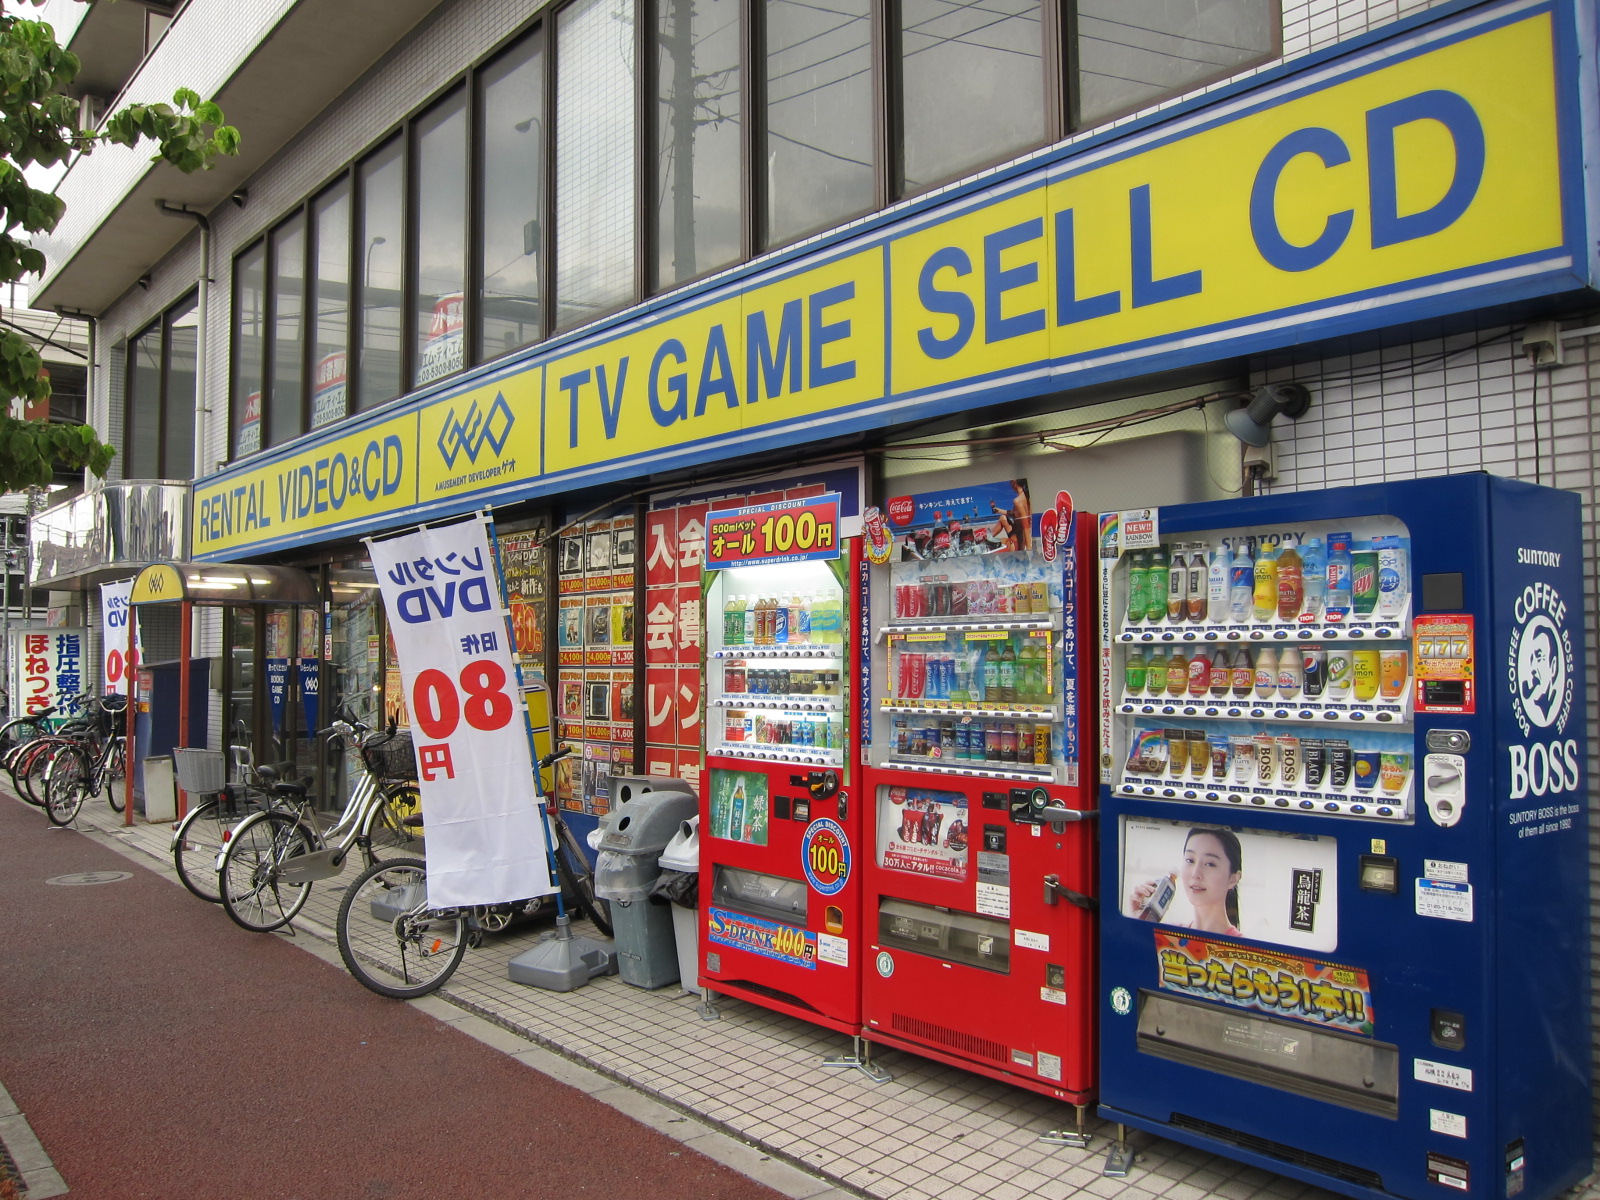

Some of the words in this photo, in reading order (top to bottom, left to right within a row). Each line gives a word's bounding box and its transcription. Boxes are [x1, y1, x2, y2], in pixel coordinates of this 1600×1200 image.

[917, 183, 1202, 360] SELL
[1249, 89, 1486, 273] CD
[559, 356, 630, 449] TV
[647, 280, 856, 428] GAME
[200, 480, 270, 543] RENTAL
[278, 435, 403, 524] VIDEO&CD
[434, 477, 467, 492] AMUSEMENT
[468, 468, 502, 484] DEVELOPER
[502, 460, 516, 475] ゲオ
[738, 506, 766, 518] SPECIAL
[770, 499, 807, 514] DISCOUNT
[889, 500, 913, 516] Coca-Cola
[712, 518, 757, 538] 500mlペット
[712, 533, 757, 558] オール
[761, 511, 832, 554] 100円
[1044, 526, 1055, 560] Coca-Cola
[1125, 533, 1153, 543] RAINBOW
[1126, 523, 1152, 533] NEW!!
[523, 549, 540, 560] DVD
[731, 552, 808, 570] http://www.superdrink.co.jp/
[1517, 547, 1561, 569] SUNTORY
[862, 564, 873, 662] コカ・コーラをあけて、
[1065, 548, 1076, 671] コカ・コーラをあけて、
[1326, 614, 1342, 622] 110円
[1514, 582, 1567, 628] COFFEE
[1420, 640, 1467, 655] 777
[1508, 627, 1520, 695] COFFEE
[1561, 629, 1574, 674] BOSS
[25, 634, 54, 716] ほねつぎ
[56, 634, 81, 716] 指圧整体
[270, 675, 284, 684] BOOKS
[271, 685, 283, 694] GAME
[273, 695, 280, 704] CD
[1556, 681, 1574, 736] COFFEE
[1511, 697, 1530, 739] BOSS
[1260, 747, 1271, 780] BOSS
[1284, 748, 1295, 782] BOSS
[1308, 750, 1320, 782] BLACK
[1333, 751, 1345, 784] BLACK
[1508, 739, 1579, 800] BOSS
[753, 796, 765, 833] 緑茶
[1509, 810, 1538, 826] SUNTORY
[1538, 807, 1555, 821] BOSS
[1555, 805, 1559, 818] is
[1559, 804, 1567, 816] the
[1567, 803, 1580, 816] boss
[1518, 826, 1526, 839] of
[1525, 823, 1538, 837] them
[1538, 822, 1546, 835] all
[1545, 820, 1559, 834] since
[1558, 818, 1572, 832] 1992
[806, 820, 825, 841] SPECIAL
[825, 821, 848, 847] DISCOUNT
[817, 834, 835, 845] オール
[810, 844, 847, 879] 100円
[936, 864, 967, 876] cocacola.jp
[1295, 874, 1312, 921] 烏龍茶
[711, 909, 776, 950] S-DRINK
[774, 926, 815, 961] 100円
[1161, 949, 1369, 1023] 当ったらもう1本!!
